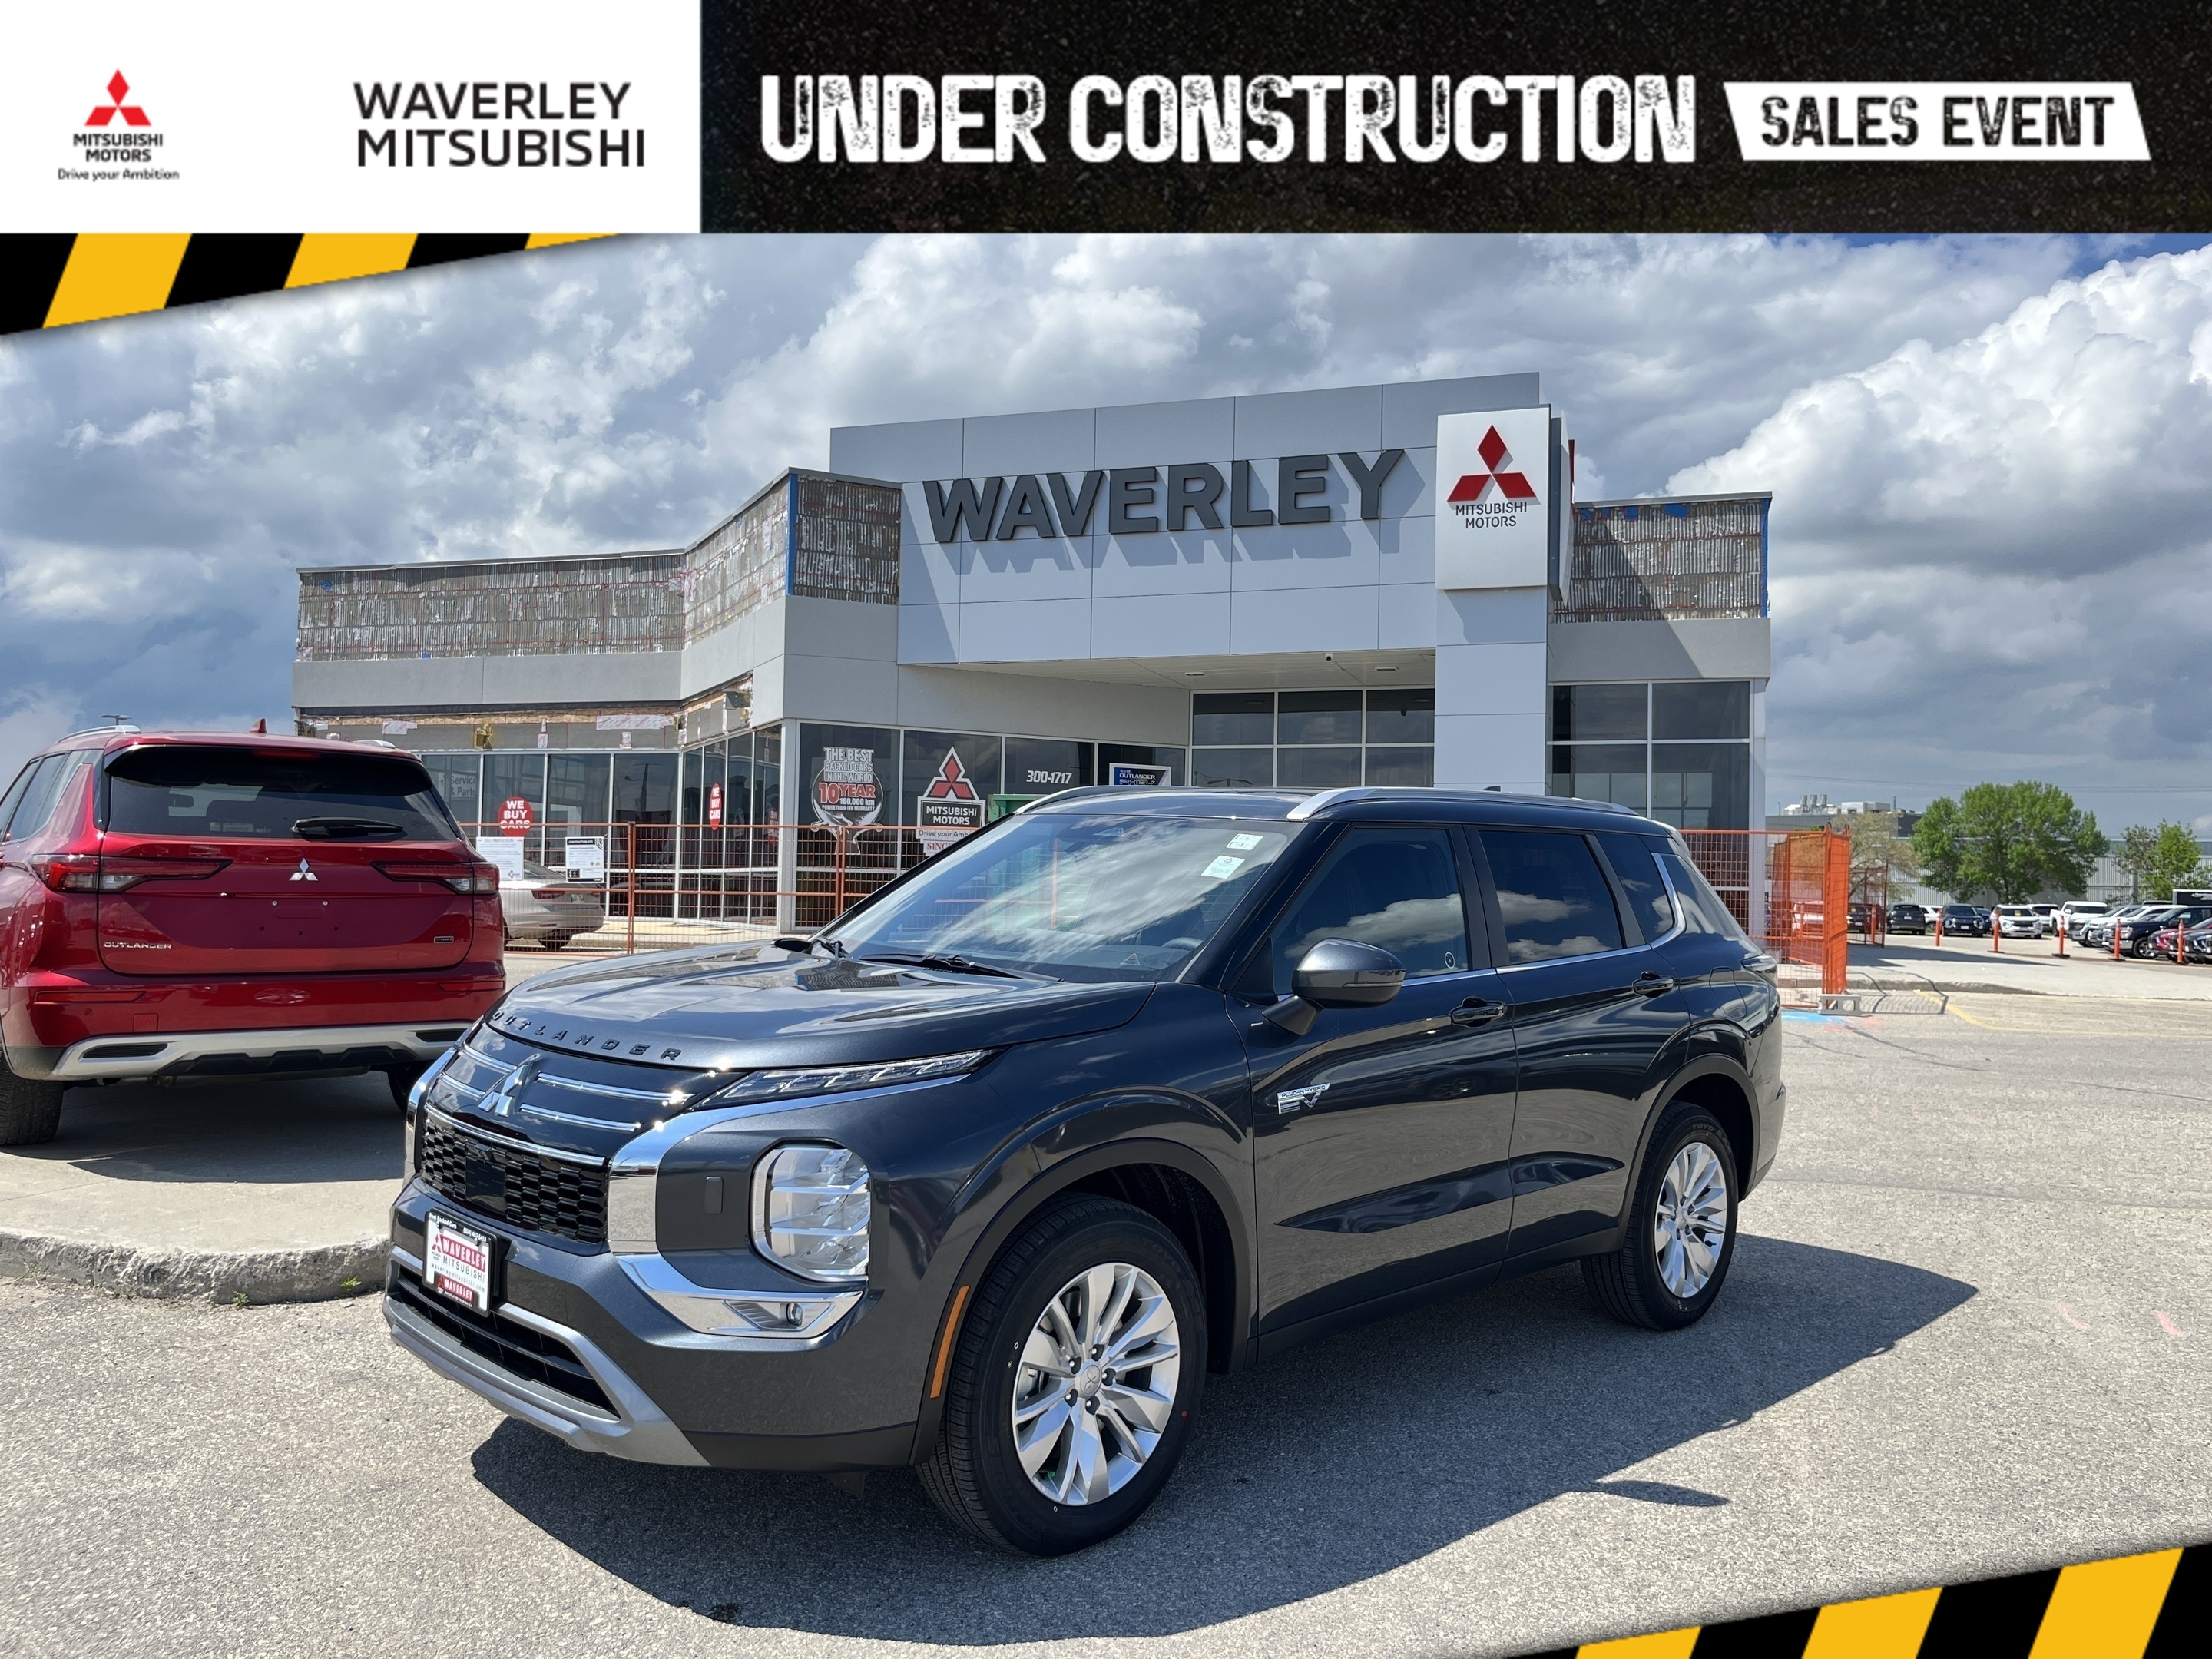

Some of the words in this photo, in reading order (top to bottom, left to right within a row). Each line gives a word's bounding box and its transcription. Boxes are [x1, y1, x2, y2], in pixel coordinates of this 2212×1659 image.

[922, 449, 1407, 543] WAVERLEY
[1455, 501, 1528, 516] MITSUBISHI
[1465, 515, 1517, 529] MOTORS
[824, 747, 845, 761] THE
[846, 748, 874, 763] BEST
[824, 762, 853, 772] BACKED
[854, 763, 874, 773] CARS
[451, 775, 476, 784] Service
[825, 772, 833, 781] IN
[833, 772, 846, 782] THE
[847, 773, 873, 783] WORLD
[1026, 770, 1072, 784] 300-1717
[458, 787, 476, 796] Parts
[820, 783, 839, 804] 10
[839, 783, 876, 798] YEAR
[507, 800, 525, 810] WE
[926, 806, 977, 816] MITSUBISHI
[503, 810, 528, 820] BUY
[933, 816, 970, 825] MOTORS
[500, 820, 531, 829] CARS
[492, 1012, 682, 1061] OUTLANDER
[442, 1237, 485, 1270] WAVERLEY
[443, 1255, 485, 1283] MITSUBISHI
[444, 1277, 473, 1300] WAVERLEY
